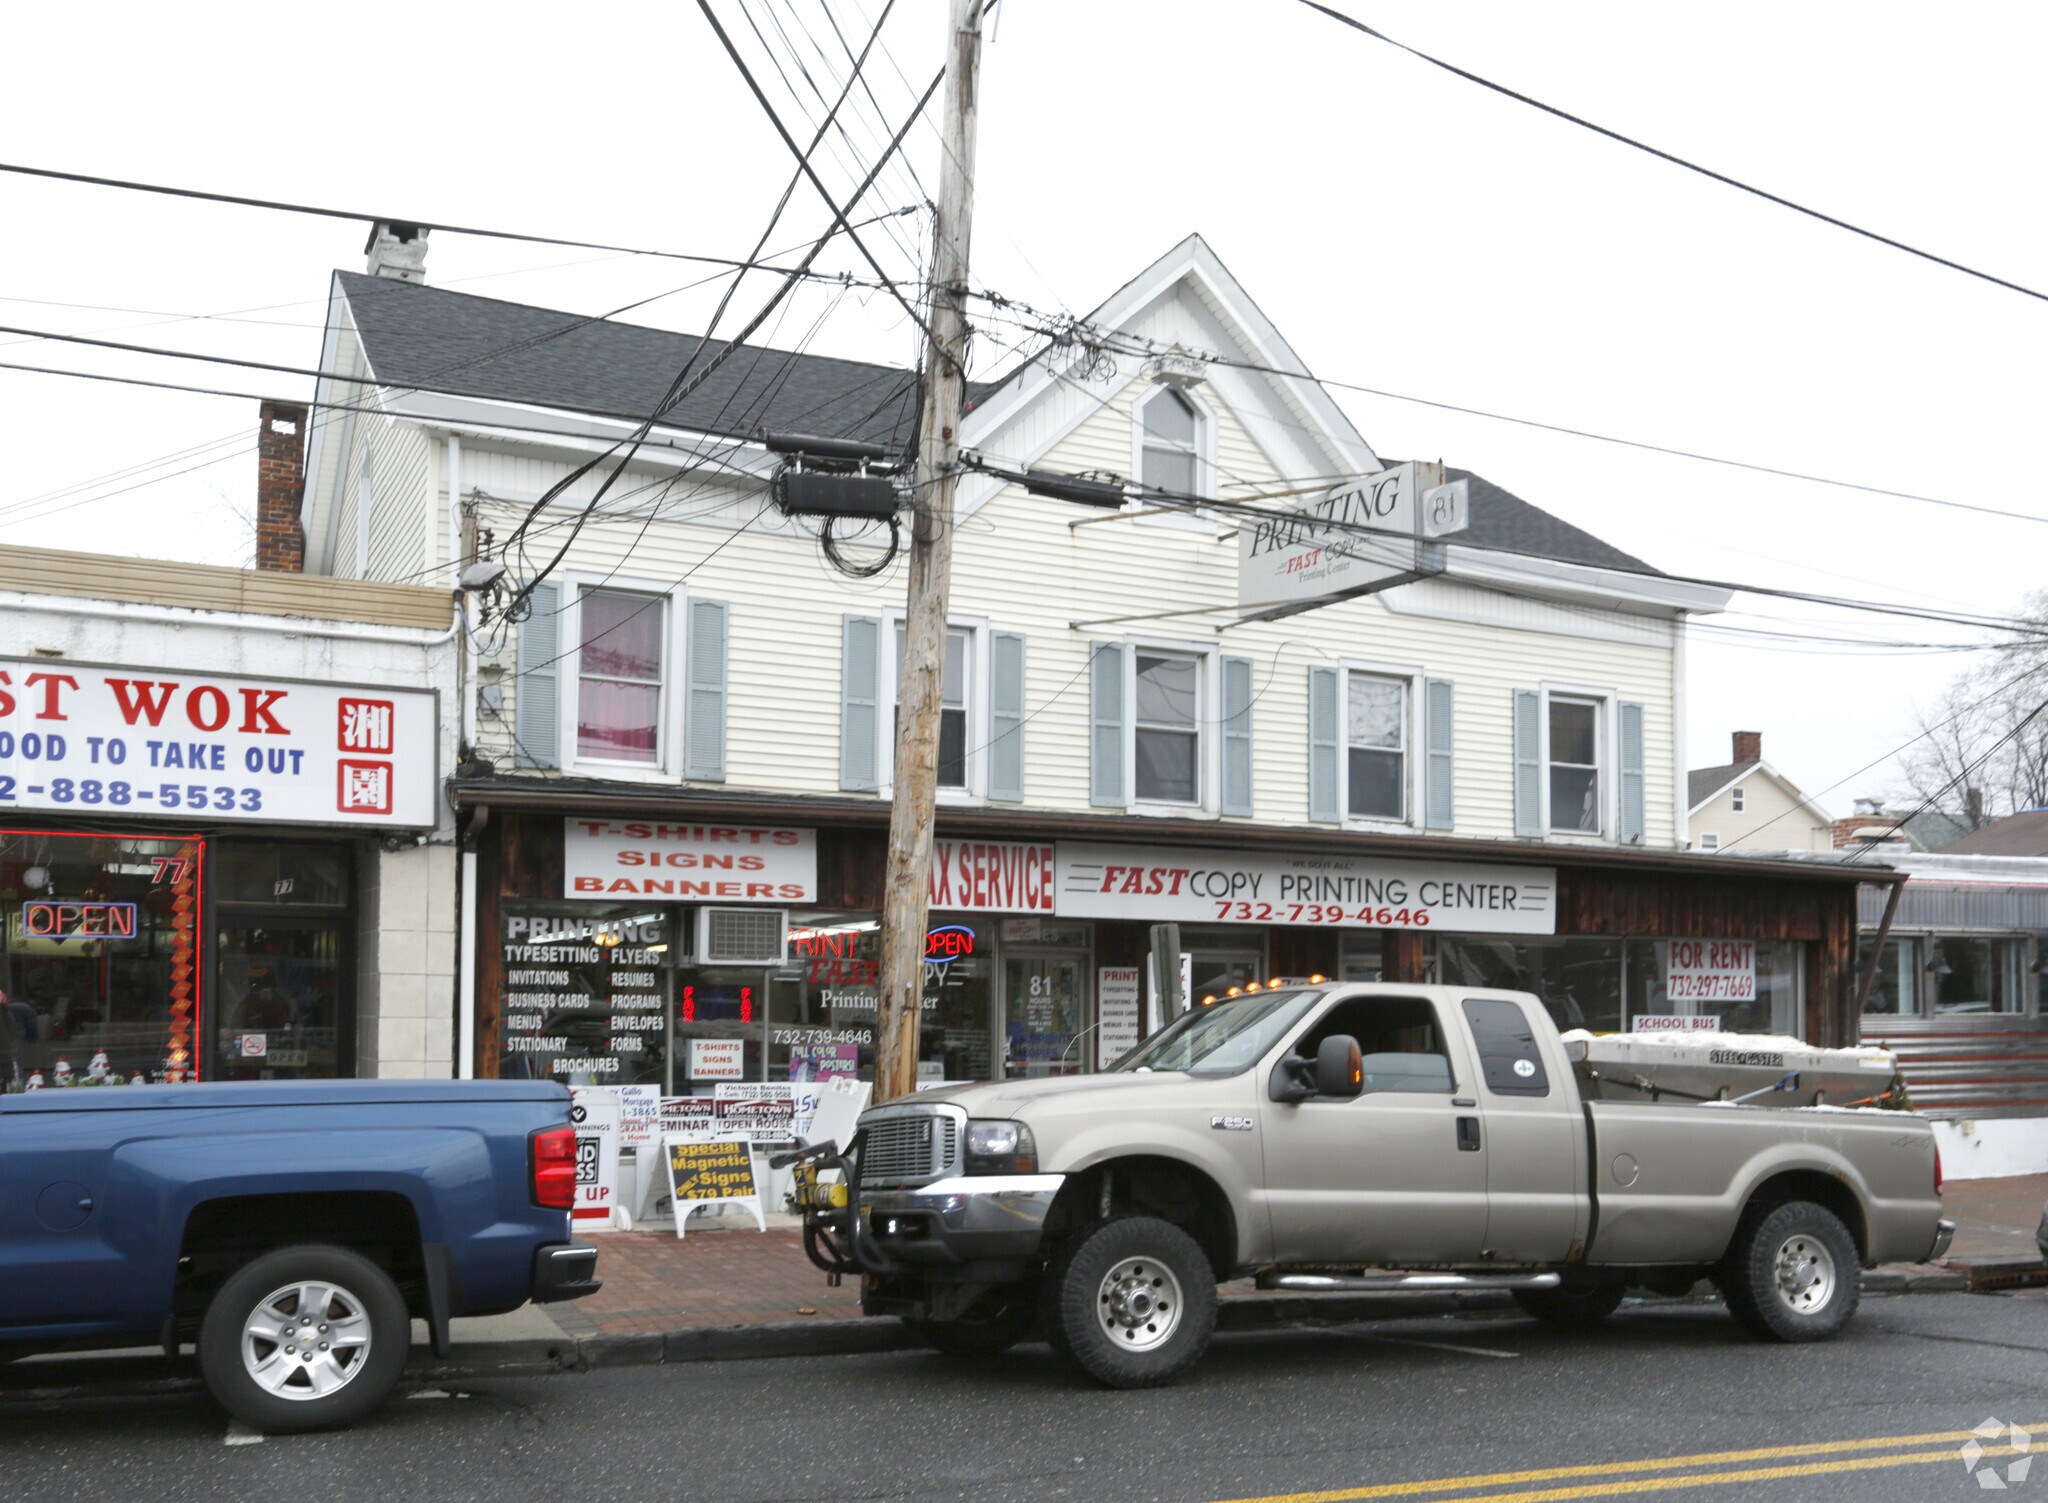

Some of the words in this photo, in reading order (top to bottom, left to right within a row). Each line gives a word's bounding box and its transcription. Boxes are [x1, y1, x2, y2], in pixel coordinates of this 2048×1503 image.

[1287, 548, 1322, 574] FAST
[104, 678, 291, 735] WOK
[87, 737, 126, 765] TO
[146, 740, 225, 771] TAKE
[245, 747, 304, 775] OUT
[578, 821, 800, 846] T-SHIRTS
[151, 857, 188, 885] 77
[616, 851, 766, 871] SIGNS
[958, 842, 1052, 909] SERVICE
[574, 877, 805, 899] BANNERS
[1281, 874, 1409, 905] PRINTING
[1419, 881, 1518, 910] CENTER
[28, 904, 132, 936] OPEN
[1214, 901, 1430, 926] 732-739-4646
[508, 916, 660, 944] PRINTING
[504, 945, 600, 963] TYPESETTING
[610, 948, 660, 965] FLYERS
[1671, 941, 1703, 969] FOR
[1710, 942, 1753, 970] RENT
[508, 970, 570, 986] INVITATIONS
[611, 972, 655, 987] RESUMES
[1029, 975, 1052, 996] 81
[1670, 975, 1753, 997] 732-297-7669
[508, 993, 556, 1008] BUSINESS
[558, 993, 590, 1008] CARDS
[610, 994, 662, 1009] PROGRAMS
[507, 1015, 542, 1030] MENUS
[610, 1015, 664, 1031] ENVELOPES
[1638, 1017, 1687, 1029] SCHOOL
[1692, 1018, 1715, 1029] BUS
[507, 1037, 568, 1052] STATIONARY
[610, 1037, 643, 1052] FORMS
[773, 1029, 872, 1044] 732-739-4646
[552, 1057, 620, 1074] BROCHURES
[693, 1068, 741, 1076] BANNERS
[722, 1120, 752, 1130] OPEN
[755, 1119, 792, 1129] HOUSE
[677, 1143, 739, 1157] Special
[671, 1154, 751, 1171] Magnetic
[699, 1171, 751, 1187] Signs
[586, 1186, 609, 1201] UP
[687, 1188, 718, 1200] $79
[722, 1185, 755, 1198] Pair
